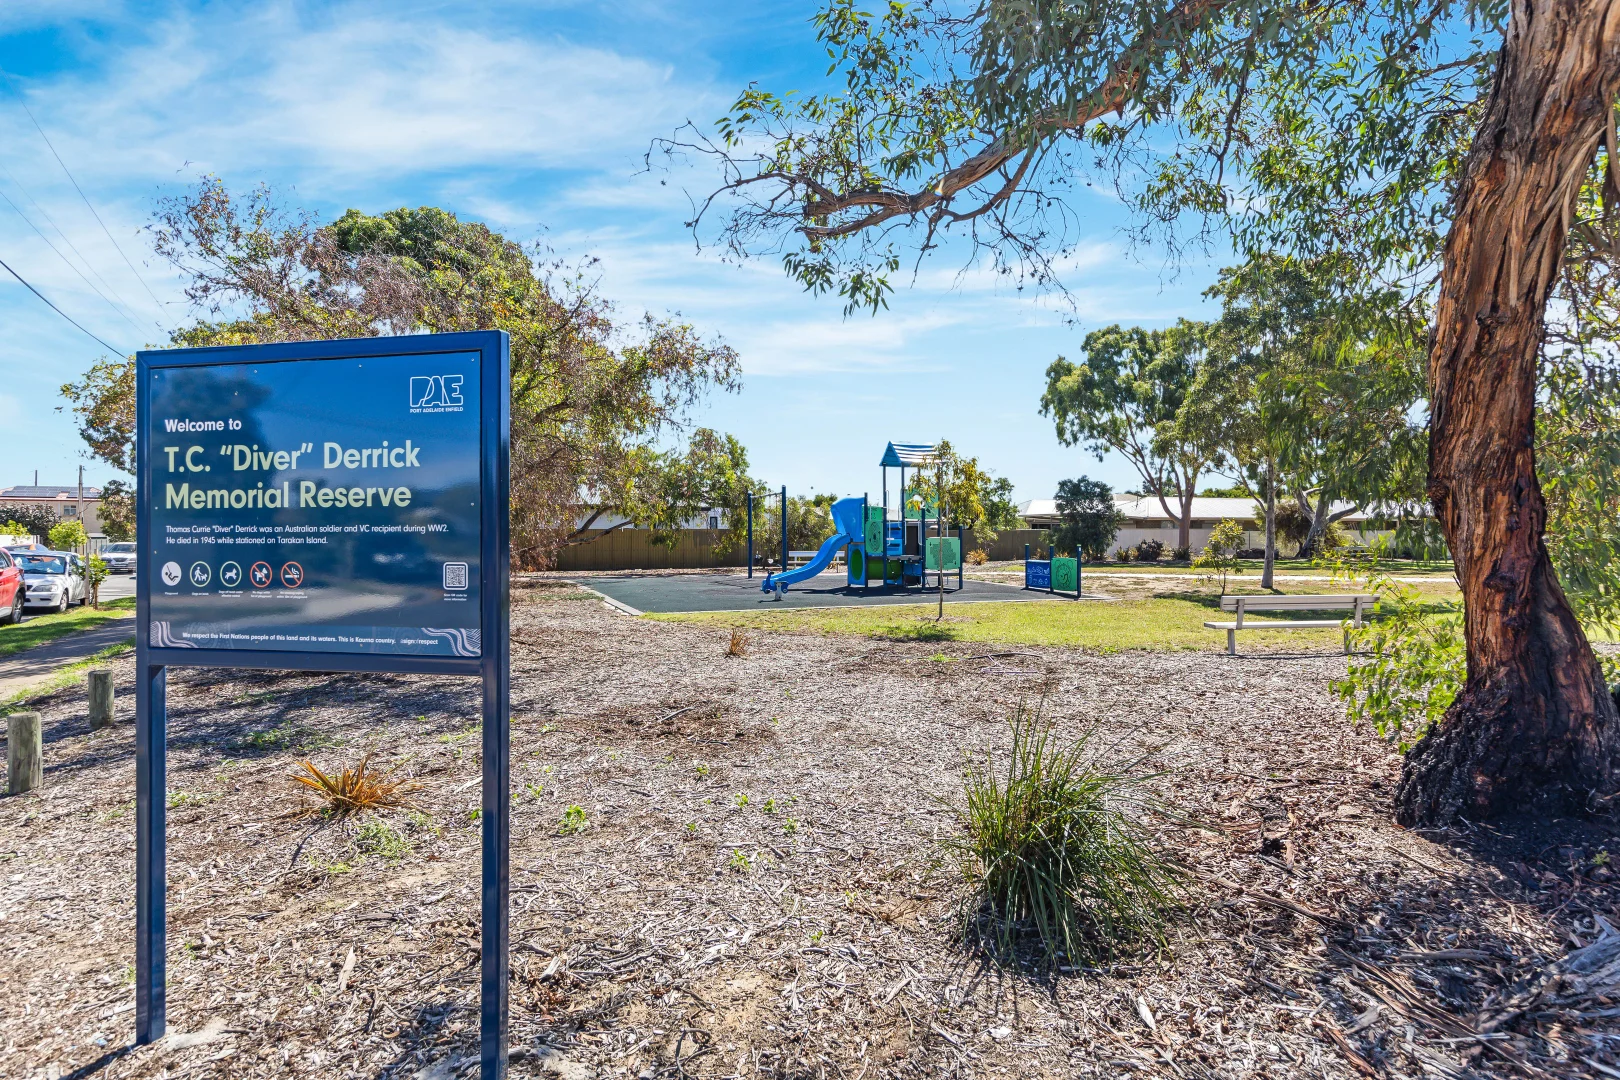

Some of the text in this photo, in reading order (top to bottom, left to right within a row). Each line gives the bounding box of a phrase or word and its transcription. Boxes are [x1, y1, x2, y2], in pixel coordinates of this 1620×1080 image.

[164, 418, 242, 432] Welcome to
[164, 446, 211, 473] T.C.
[323, 440, 420, 470] Derrick
[166, 480, 412, 510] Memorial Reserve
[166, 525, 191, 533] Thomas
[192, 525, 211, 533] Currie
[371, 524, 402, 534] recipient
[403, 524, 426, 534] during
[428, 524, 449, 532] WW2.
